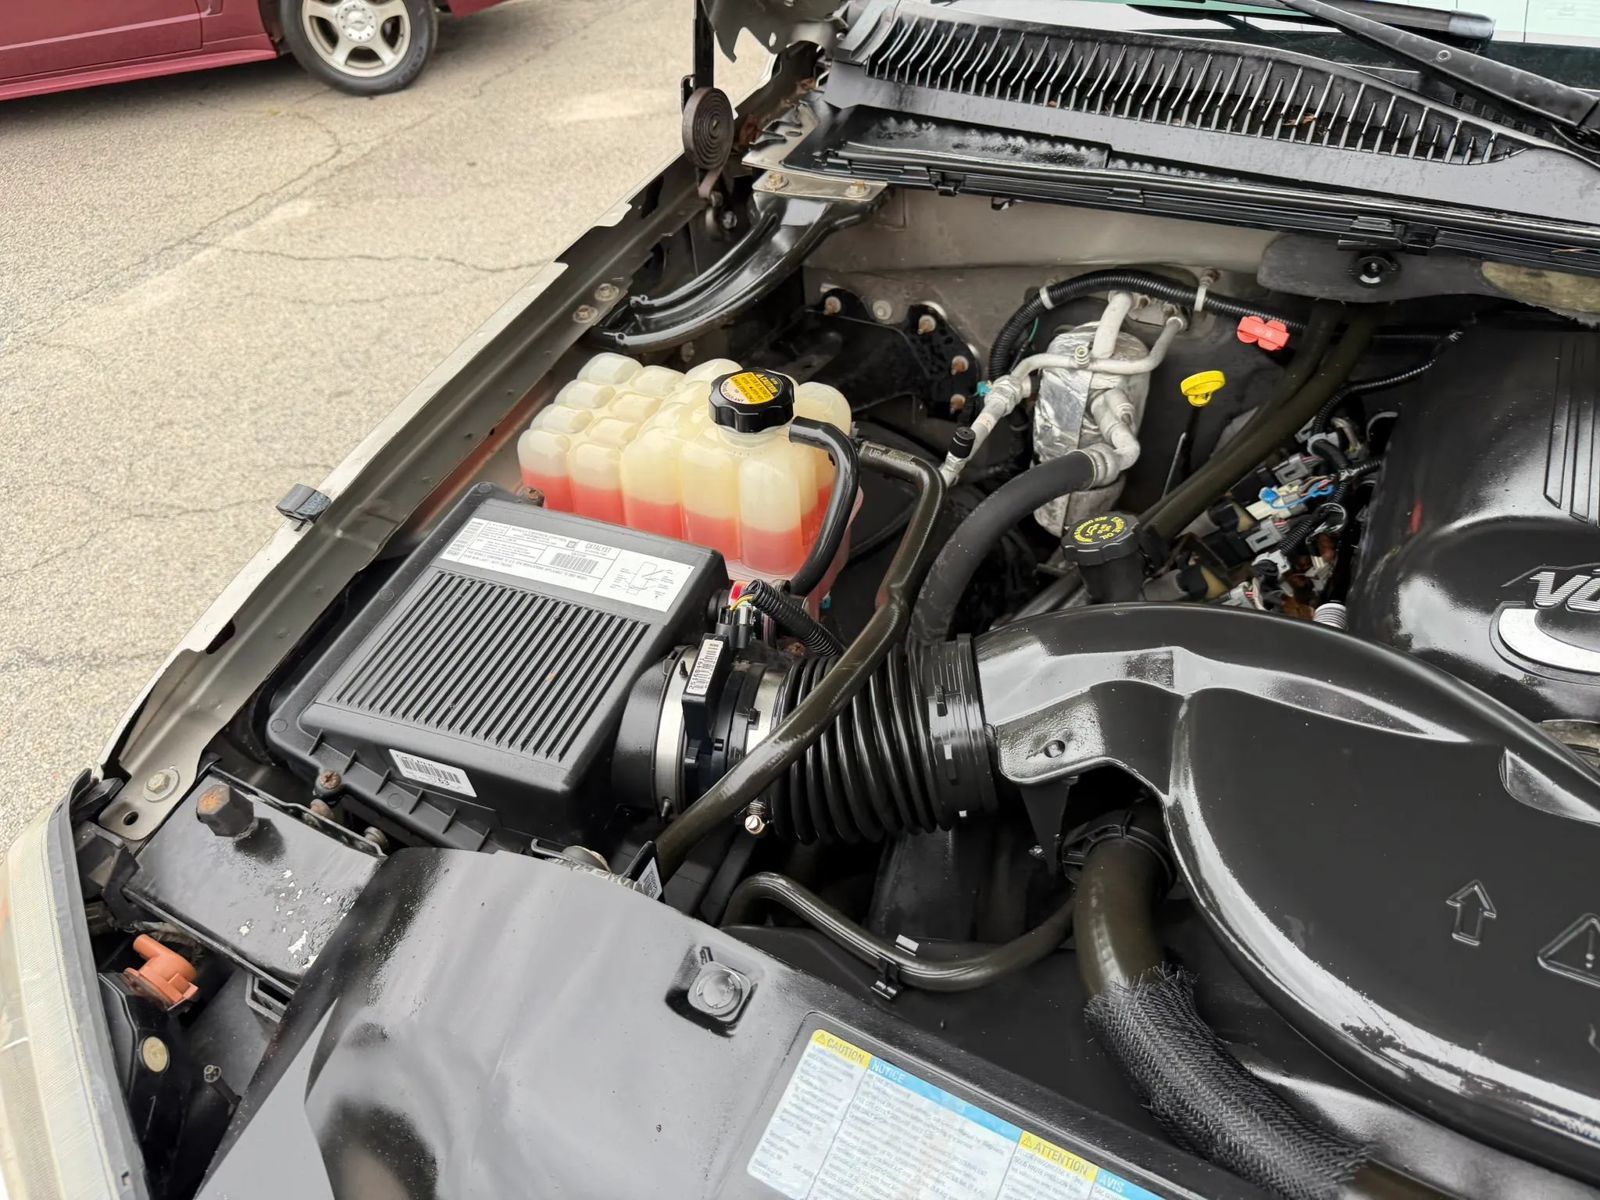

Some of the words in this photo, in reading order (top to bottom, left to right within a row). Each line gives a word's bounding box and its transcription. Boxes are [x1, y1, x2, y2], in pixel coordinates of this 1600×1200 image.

[826, 1037, 865, 1065] CAUTION
[872, 1060, 907, 1085] NOTICE
[1034, 1142, 1089, 1177] ATTENTION
[1100, 1173, 1125, 1193] AVIS
